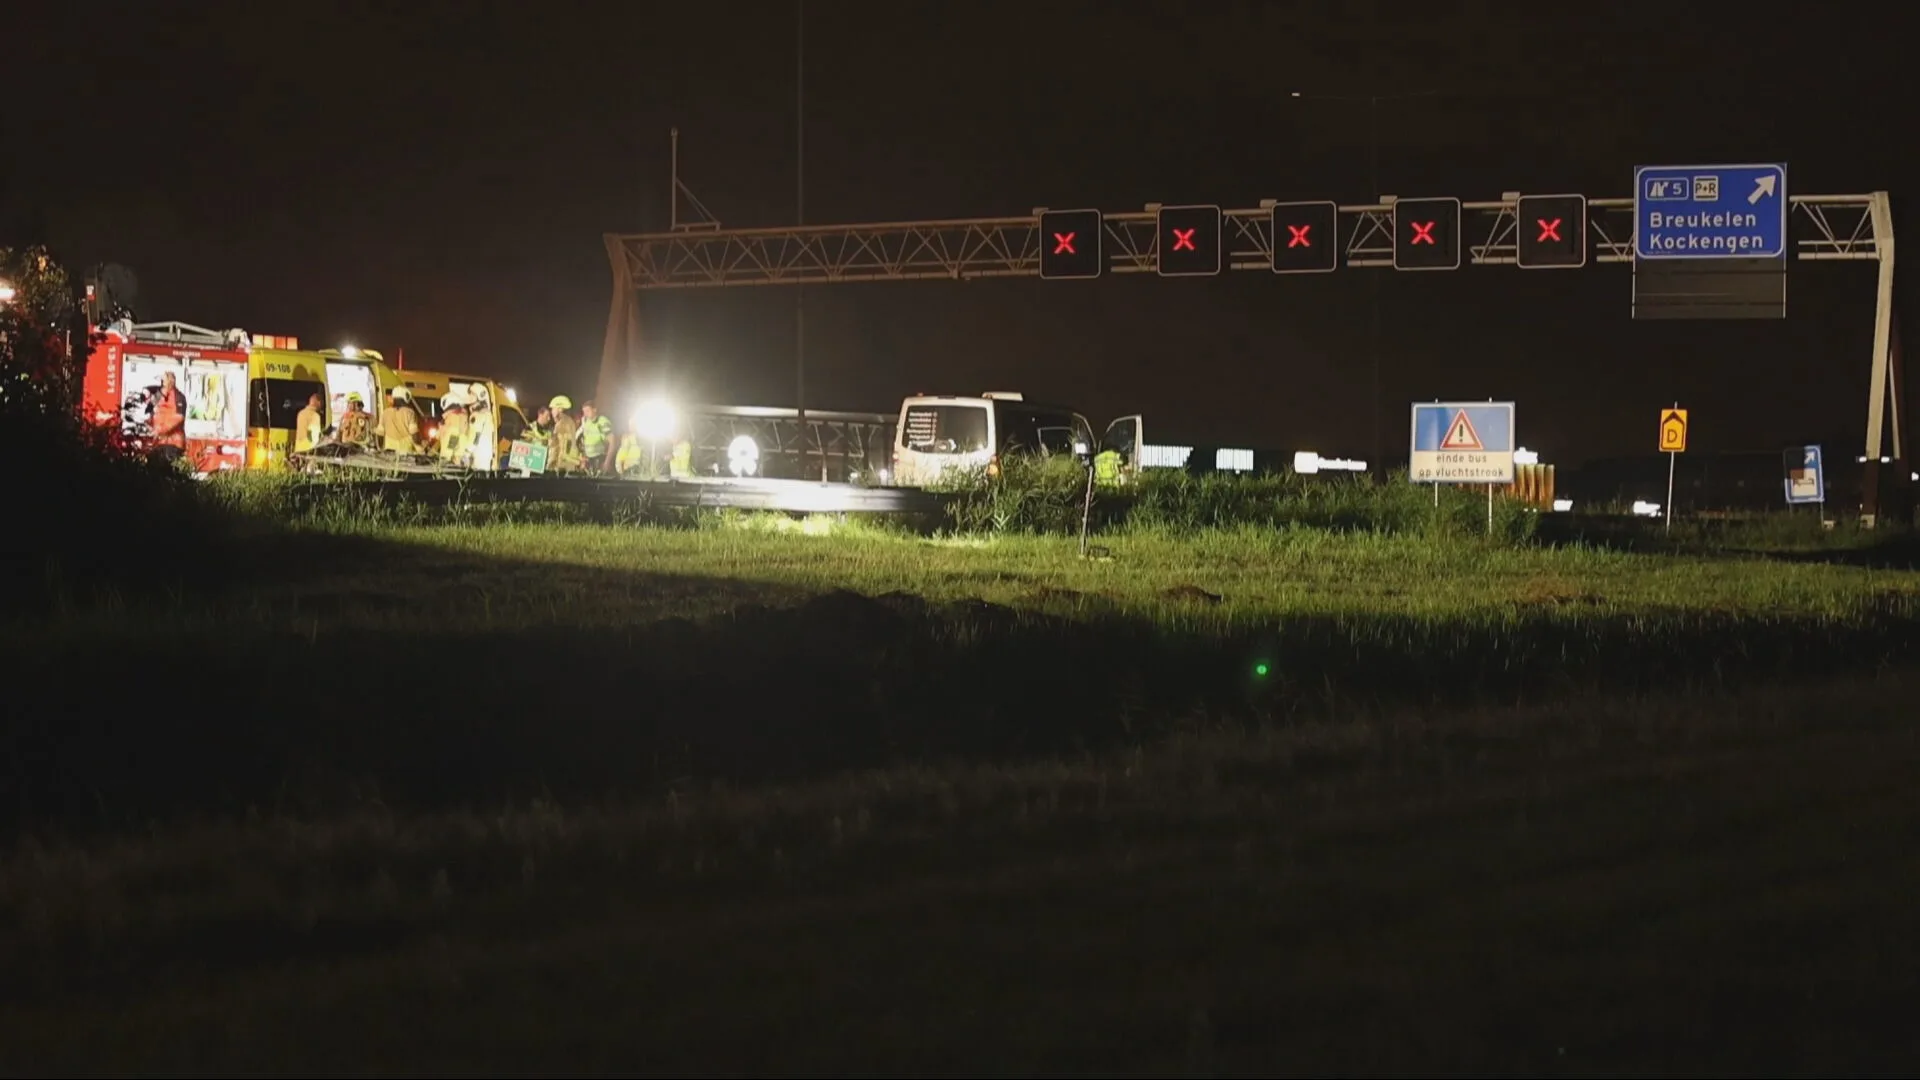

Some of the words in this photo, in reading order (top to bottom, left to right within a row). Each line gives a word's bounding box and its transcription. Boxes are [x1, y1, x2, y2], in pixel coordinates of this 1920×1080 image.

[1673, 182, 1682, 195] 5
[1695, 182, 1717, 194] P+R
[1650, 210, 1757, 228] Breukelen
[1650, 233, 1763, 253] Kockengen
[1667, 429, 1678, 443] D
[1436, 454, 1465, 463] einde
[1468, 454, 1487, 463] bus
[1419, 469, 1431, 478] op
[1436, 467, 1504, 477] vluchtstrook
